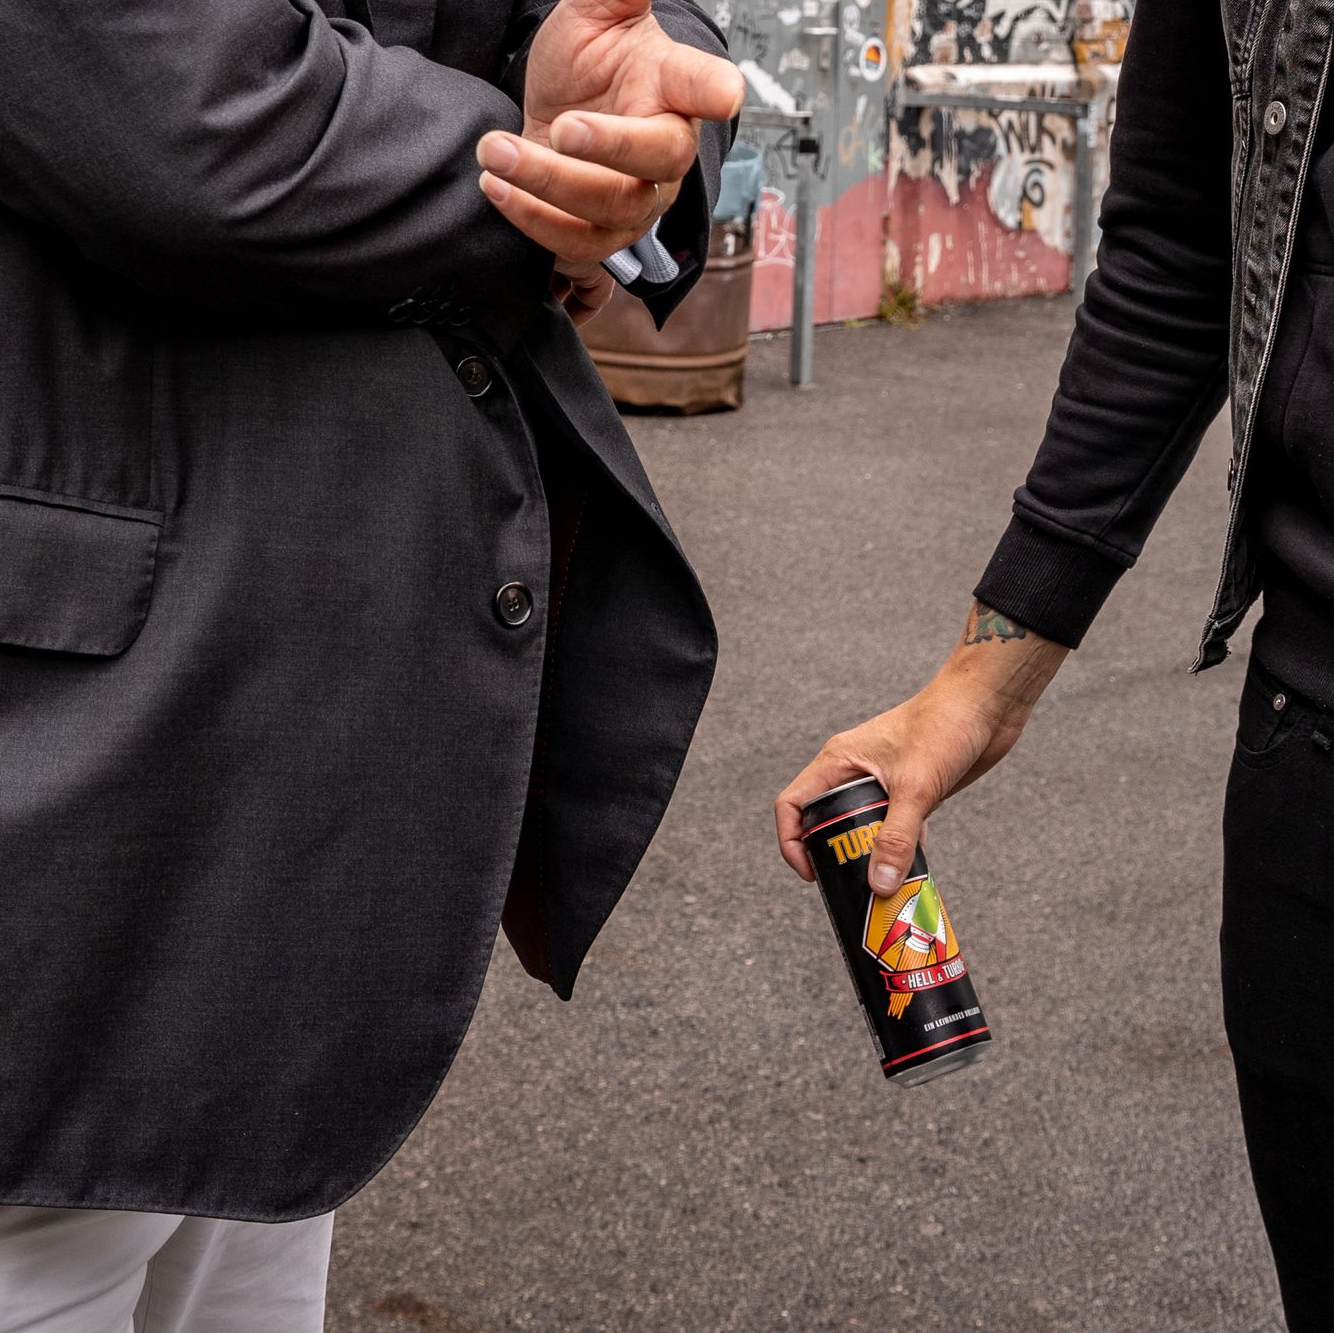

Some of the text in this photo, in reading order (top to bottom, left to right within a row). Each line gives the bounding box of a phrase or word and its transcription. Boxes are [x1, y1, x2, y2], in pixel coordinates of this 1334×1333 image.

[907, 970, 936, 989] HELL
[936, 972, 944, 982] &
[923, 1021, 936, 1032] EIN
